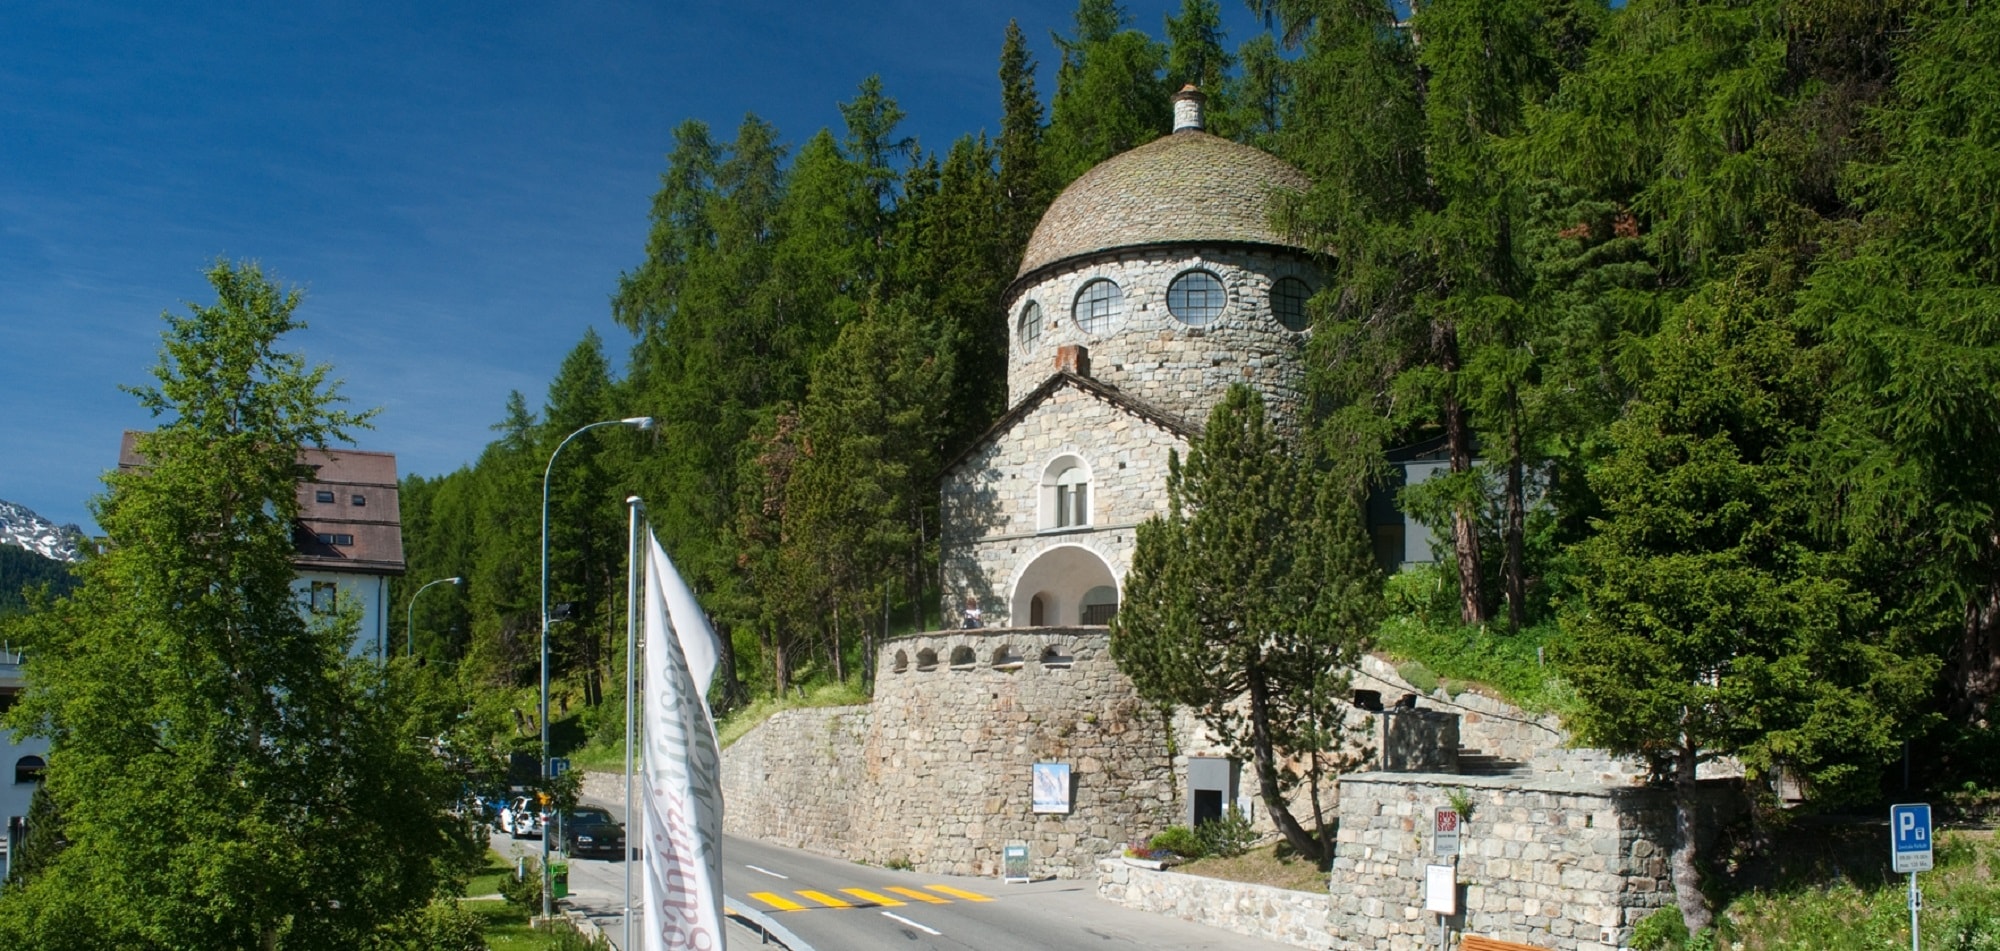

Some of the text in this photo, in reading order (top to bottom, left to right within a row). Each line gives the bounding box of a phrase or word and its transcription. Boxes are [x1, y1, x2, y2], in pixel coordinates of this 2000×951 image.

[558, 762, 566, 776] P
[1438, 811, 1456, 823] BUS
[1438, 822, 1457, 831] STOP
[1900, 812, 1914, 841] P
